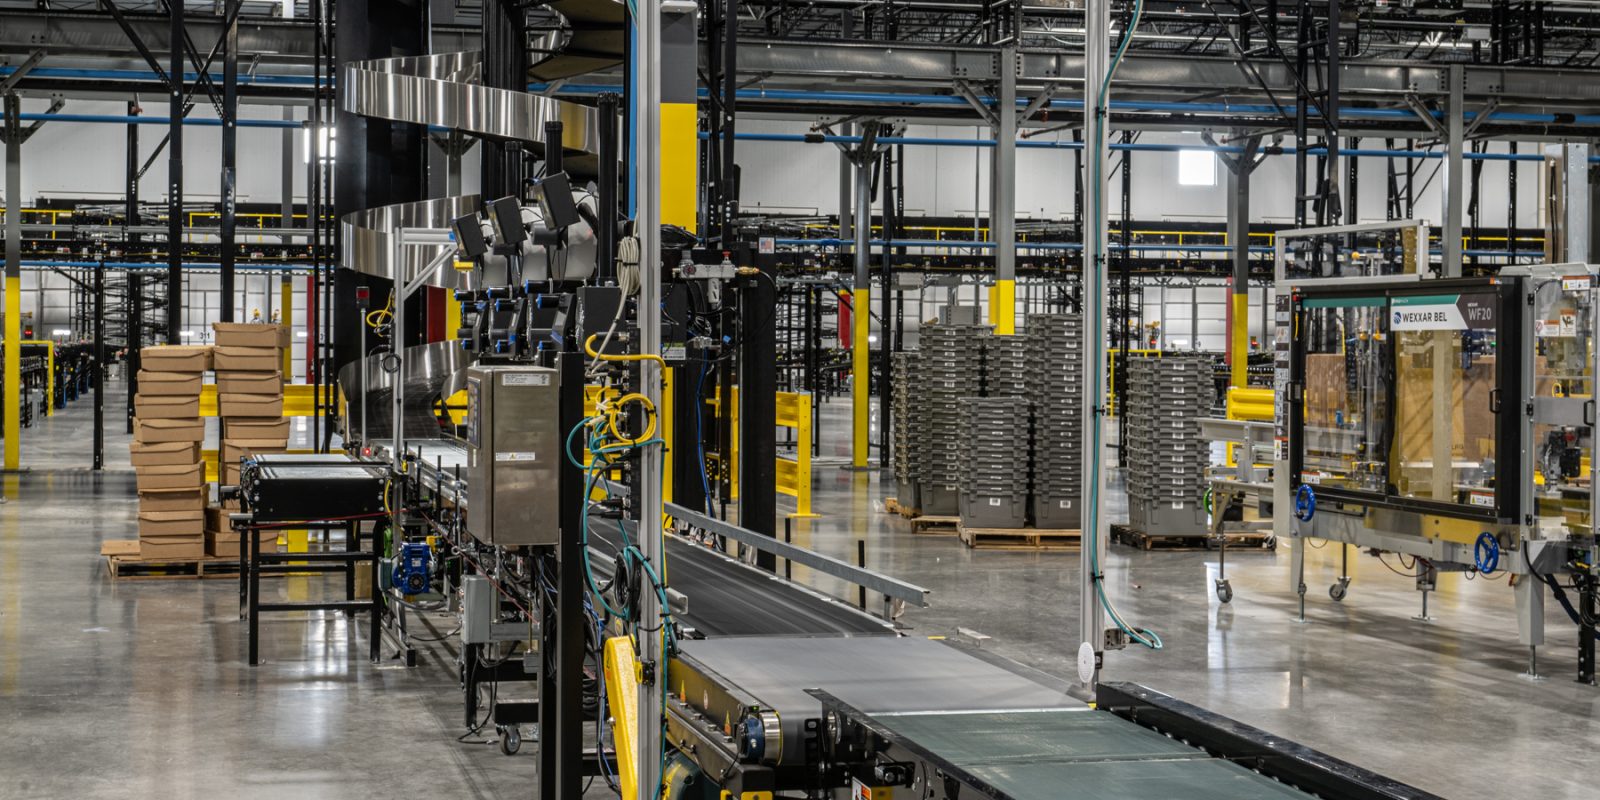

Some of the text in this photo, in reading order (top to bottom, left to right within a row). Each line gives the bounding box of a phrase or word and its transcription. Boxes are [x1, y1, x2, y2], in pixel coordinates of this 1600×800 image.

[1402, 312, 1447, 322] WEXXAR BEL
[1468, 307, 1491, 320] WF20
